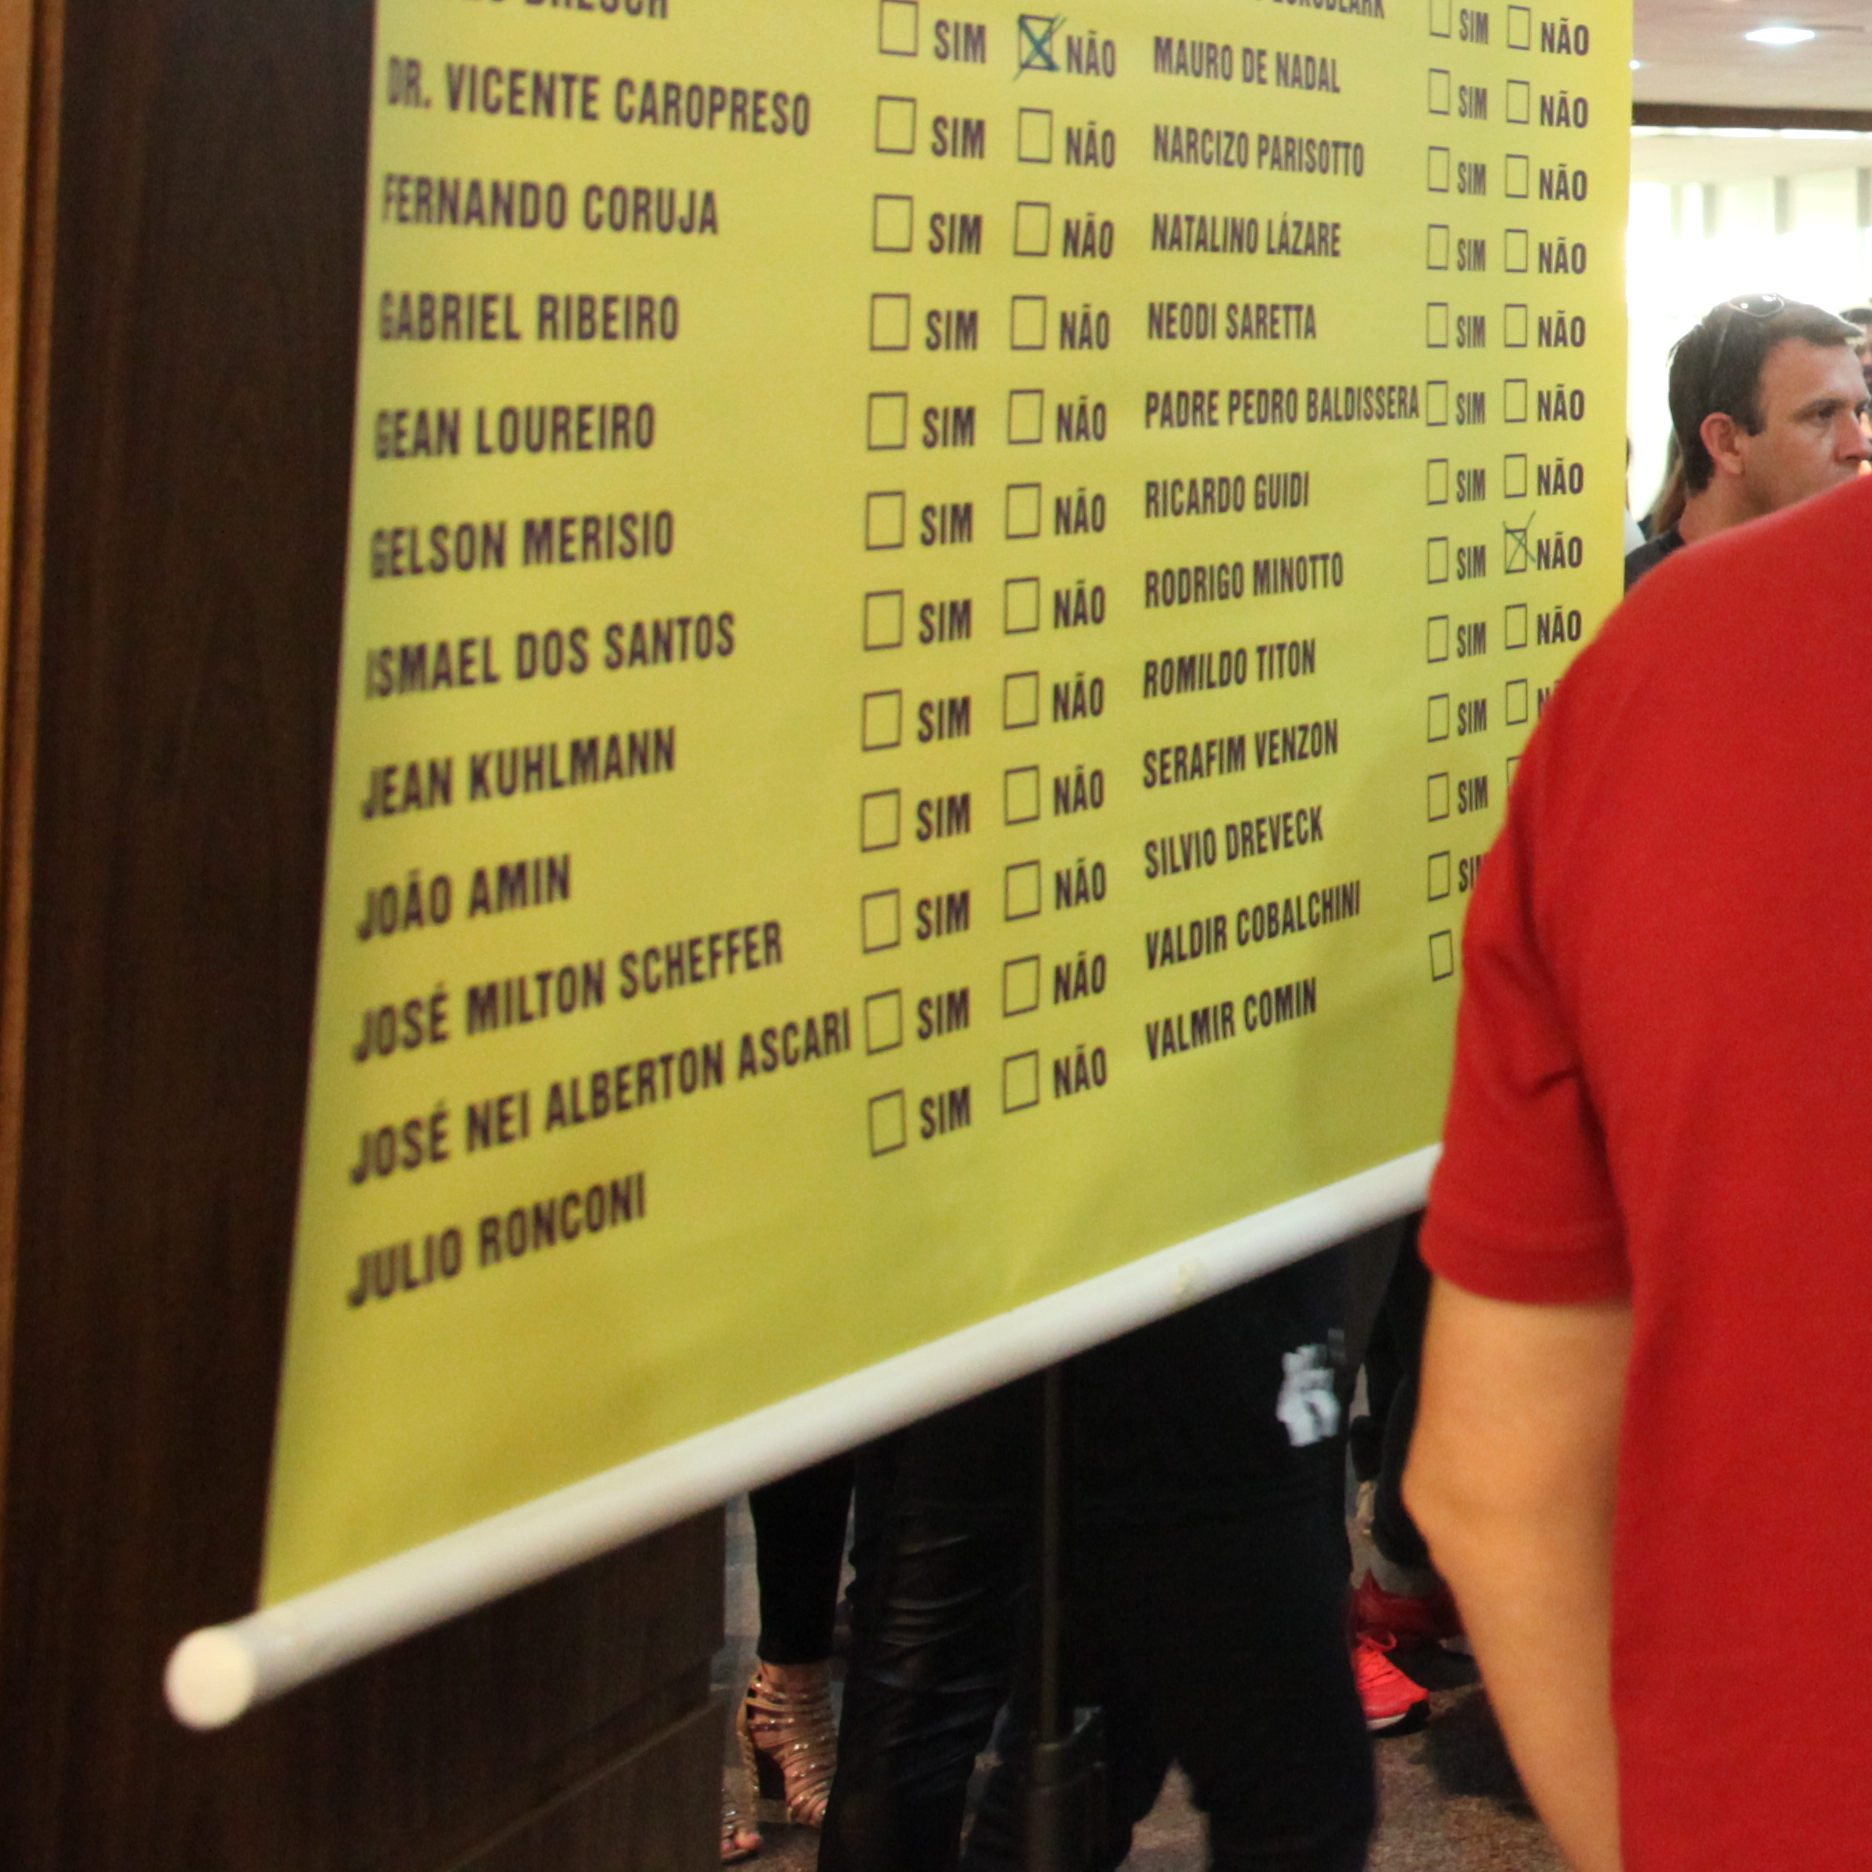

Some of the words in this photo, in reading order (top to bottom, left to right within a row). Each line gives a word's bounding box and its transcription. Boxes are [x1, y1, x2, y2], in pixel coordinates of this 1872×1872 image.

[933, 18, 987, 64] SIM
[1066, 29, 1116, 78] NÃO
[1459, 8, 1489, 44] SIM
[1540, 17, 1590, 57] NÃO
[1153, 35, 1234, 81] MAURO
[1242, 47, 1268, 85] DE
[1275, 51, 1341, 94] NADAL
[389, 55, 433, 109] DR.
[446, 62, 602, 122] VICENTE
[615, 76, 812, 137] CAROPRESO
[1153, 124, 1250, 169] NARCIZO
[1257, 133, 1365, 178] PARISOTTO
[384, 173, 570, 231] FERNANDO
[583, 183, 720, 236] CORUJA
[927, 211, 984, 256] SIM
[1062, 211, 1115, 260] NÃO
[1151, 212, 1259, 255] NATALINO
[1266, 213, 1341, 258] LÁZARE
[1456, 238, 1486, 272] SIM
[1538, 236, 1587, 275] NÃO
[380, 290, 524, 342] GABRIEL
[537, 293, 681, 342] RIBEIRO
[1147, 301, 1218, 341] NEODI
[1225, 302, 1317, 341] SARETTA
[375, 407, 462, 461] GEAN
[476, 402, 657, 456] LOUREIRO
[921, 405, 977, 450] SIM
[1056, 394, 1108, 443] NÃO
[1144, 388, 1221, 429] PADRE
[1227, 387, 1299, 426] PEDRO
[1306, 384, 1420, 423] BALDISSERA
[1456, 391, 1486, 426] SIM
[1537, 383, 1585, 422] NÃO
[1144, 474, 1246, 519] RICARDO
[1253, 471, 1310, 511] GUIDI
[371, 520, 509, 580] GELSON
[523, 509, 676, 567] MERISIO
[1144, 561, 1245, 609] RODRIGO
[1252, 551, 1344, 597] MINOTTO
[917, 598, 973, 646] SIM
[1053, 579, 1107, 630] NÃO
[1456, 621, 1487, 659] SIM
[1536, 605, 1583, 645] NÃO
[366, 635, 502, 700] ISMAEL
[516, 625, 592, 682] DOS
[604, 610, 737, 672] SANTOS
[1142, 647, 1249, 700] ROMILDO
[1255, 638, 1316, 682] TITON
[361, 756, 455, 822] JEAN
[469, 725, 677, 802] KUHLMANN
[1142, 734, 1247, 790] SERAFIM
[1254, 718, 1339, 769] VENZON
[915, 791, 972, 843] SIM
[1052, 764, 1105, 817] NÃO
[1143, 827, 1218, 880] SILVIO
[1224, 805, 1324, 862] DREVECK
[357, 868, 454, 943] JOÃO
[467, 852, 573, 920] AMIN
[1145, 913, 1228, 971] VALDIR
[1235, 880, 1361, 947] COBALCHINI
[352, 981, 452, 1065] JOSÉ
[466, 958, 608, 1037] MILTON
[619, 919, 785, 1001] SCHEFFER
[916, 986, 971, 1042] SIM
[1052, 950, 1108, 1005] NÃO
[1144, 1000, 1236, 1061] VALMIR
[1242, 976, 1317, 1033] COMIN
[349, 1100, 452, 1187] JOSÉ
[466, 1089, 532, 1154] NEI
[544, 1039, 727, 1133] ALBERTON
[738, 1007, 853, 1081] ASCARI
[346, 1225, 465, 1310] JULIO
[478, 1170, 647, 1268] RONCONI
